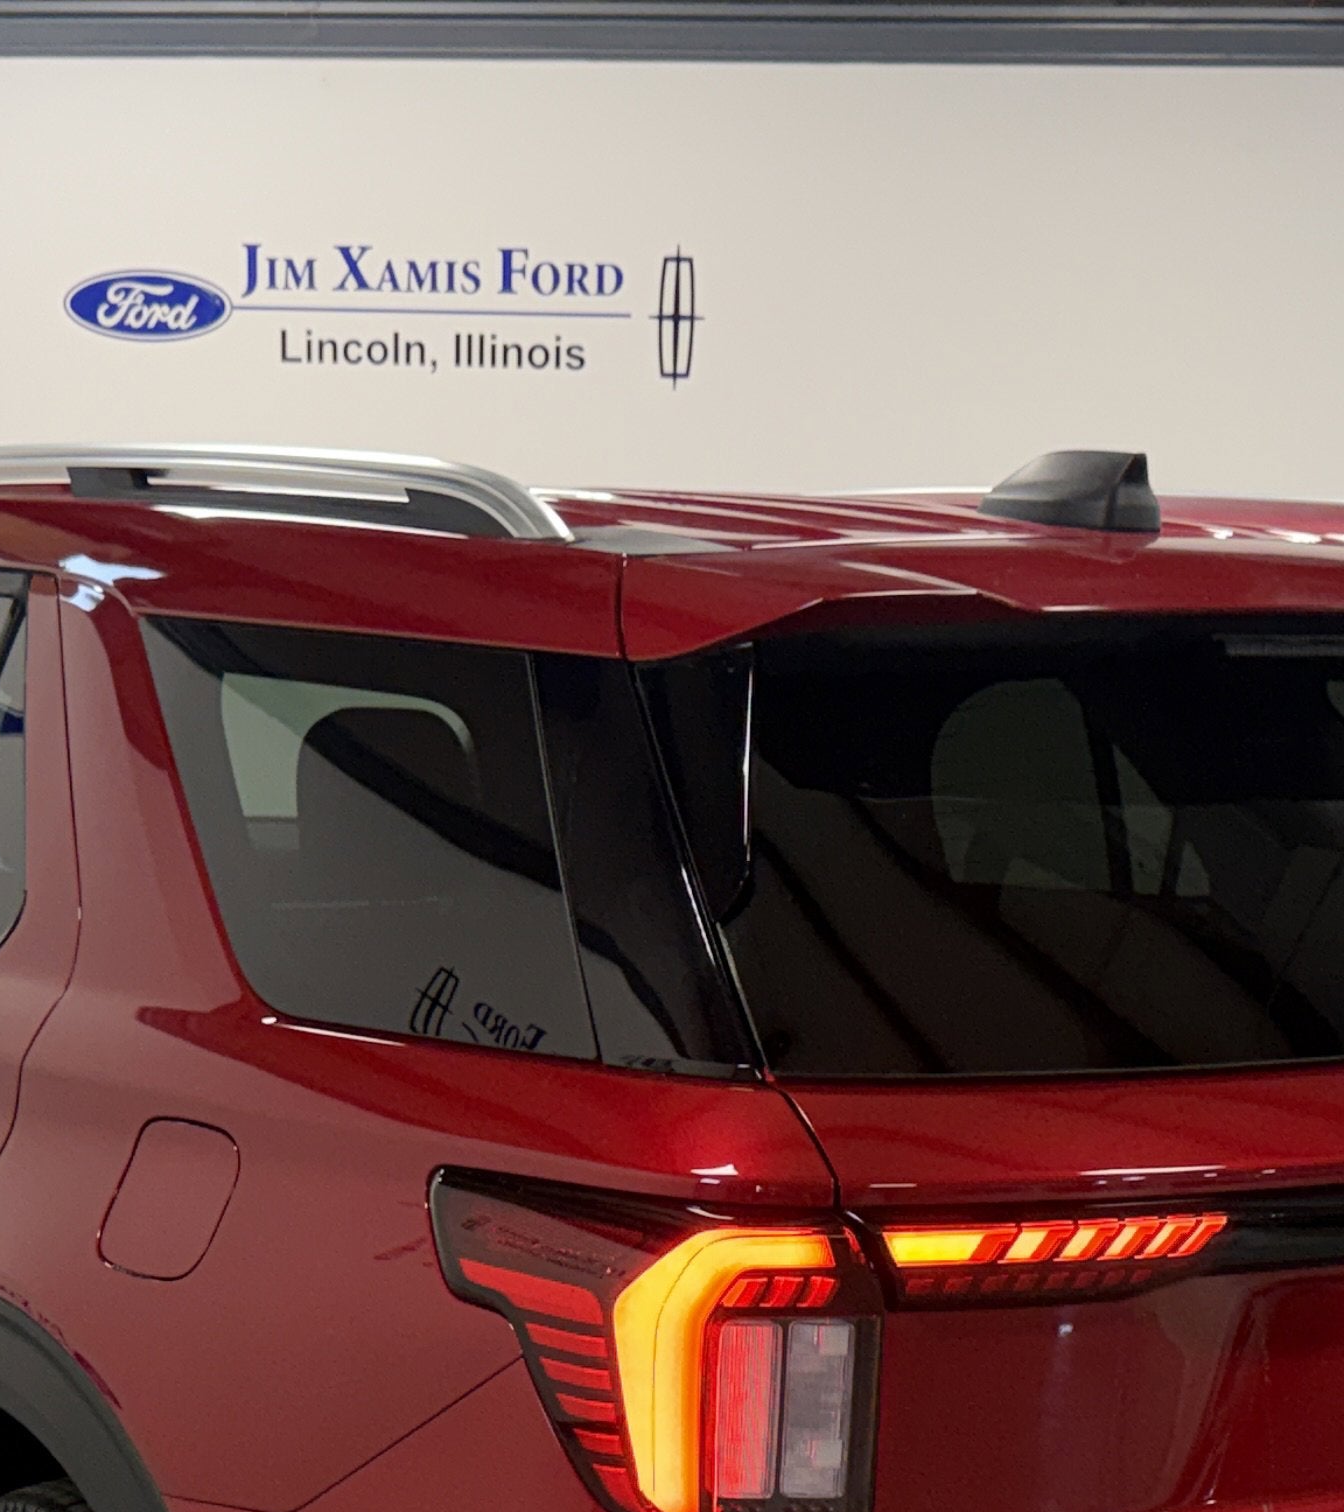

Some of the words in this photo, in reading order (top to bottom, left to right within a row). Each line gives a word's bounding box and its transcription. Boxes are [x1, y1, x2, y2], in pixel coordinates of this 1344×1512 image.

[241, 243, 316, 297] JIM
[333, 245, 482, 295] XAMIS
[497, 247, 624, 297] FORD
[96, 281, 199, 331] Ford
[280, 329, 438, 372] Lincoln,
[455, 333, 584, 370] Illinois
